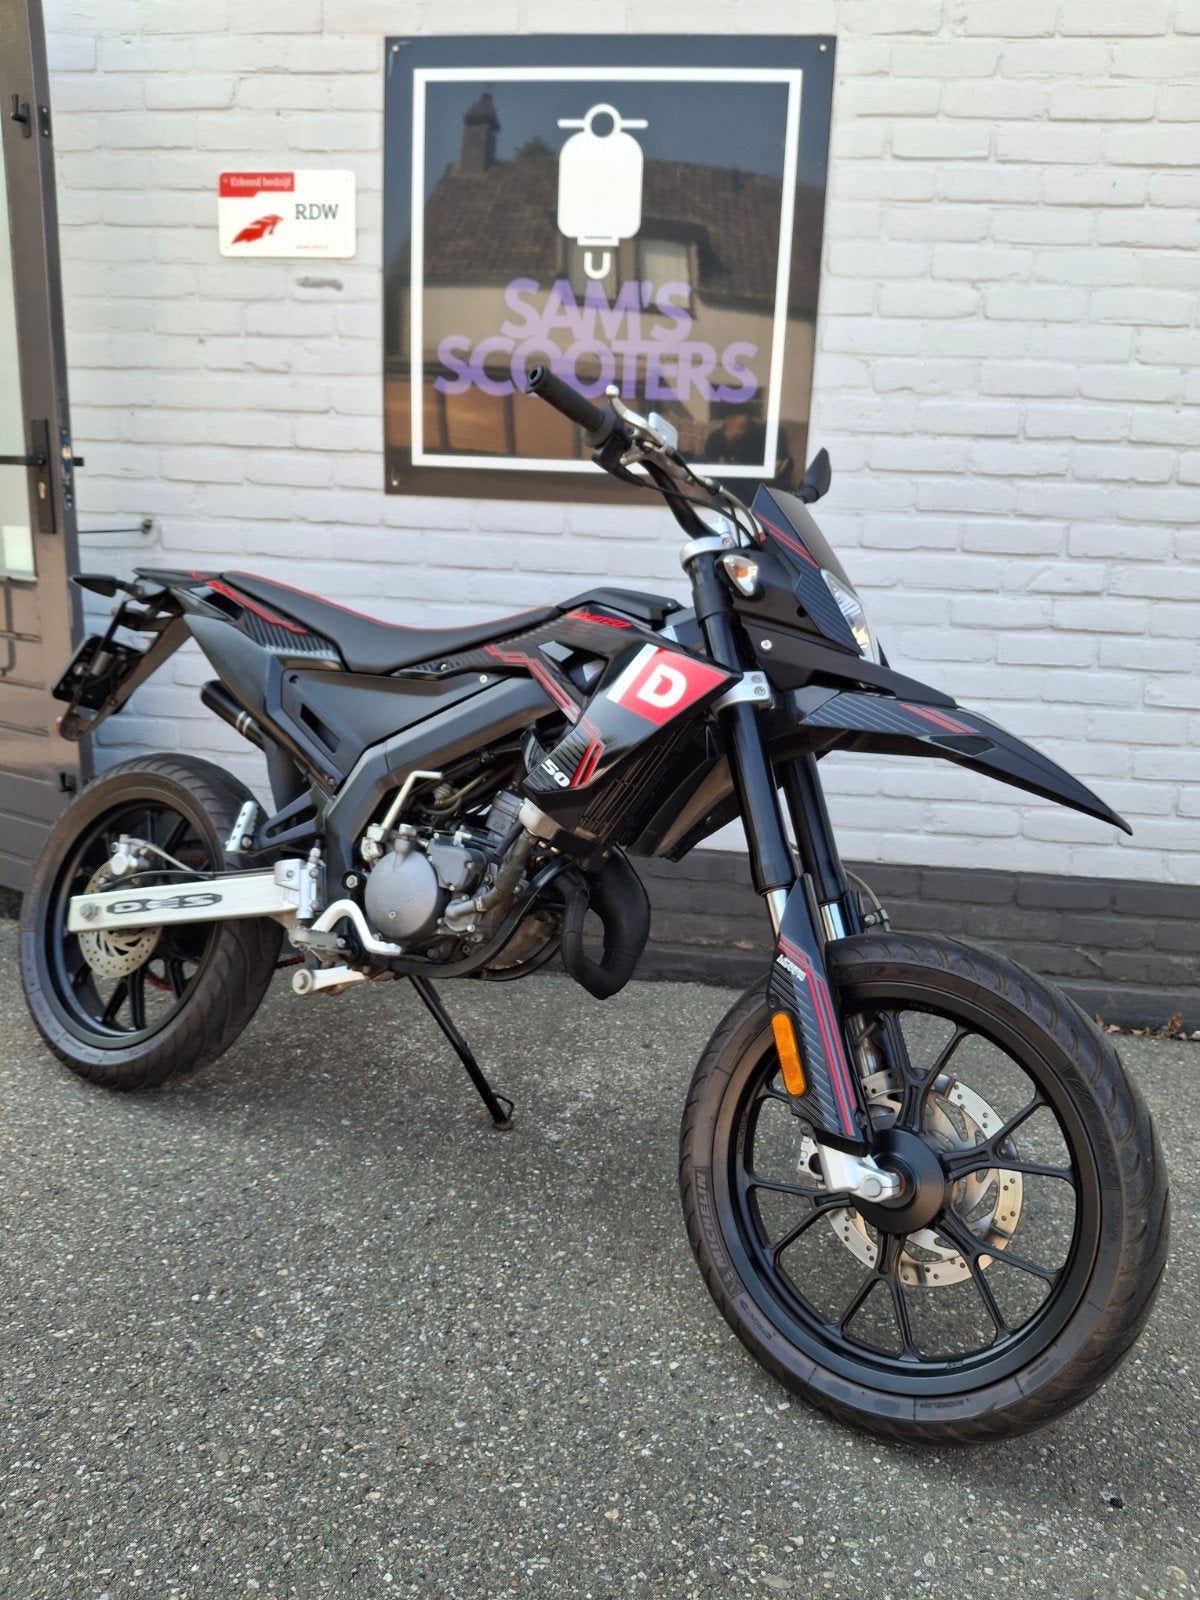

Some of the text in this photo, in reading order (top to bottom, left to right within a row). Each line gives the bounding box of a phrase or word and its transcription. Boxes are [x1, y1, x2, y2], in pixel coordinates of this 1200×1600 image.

[295, 203, 339, 220] RDW
[501, 277, 693, 341] SAM'S
[433, 334, 758, 404] SCOOTERS
[636, 663, 687, 709] D
[541, 758, 571, 787] 50
[696, 1172, 727, 1268] MICHELIN
